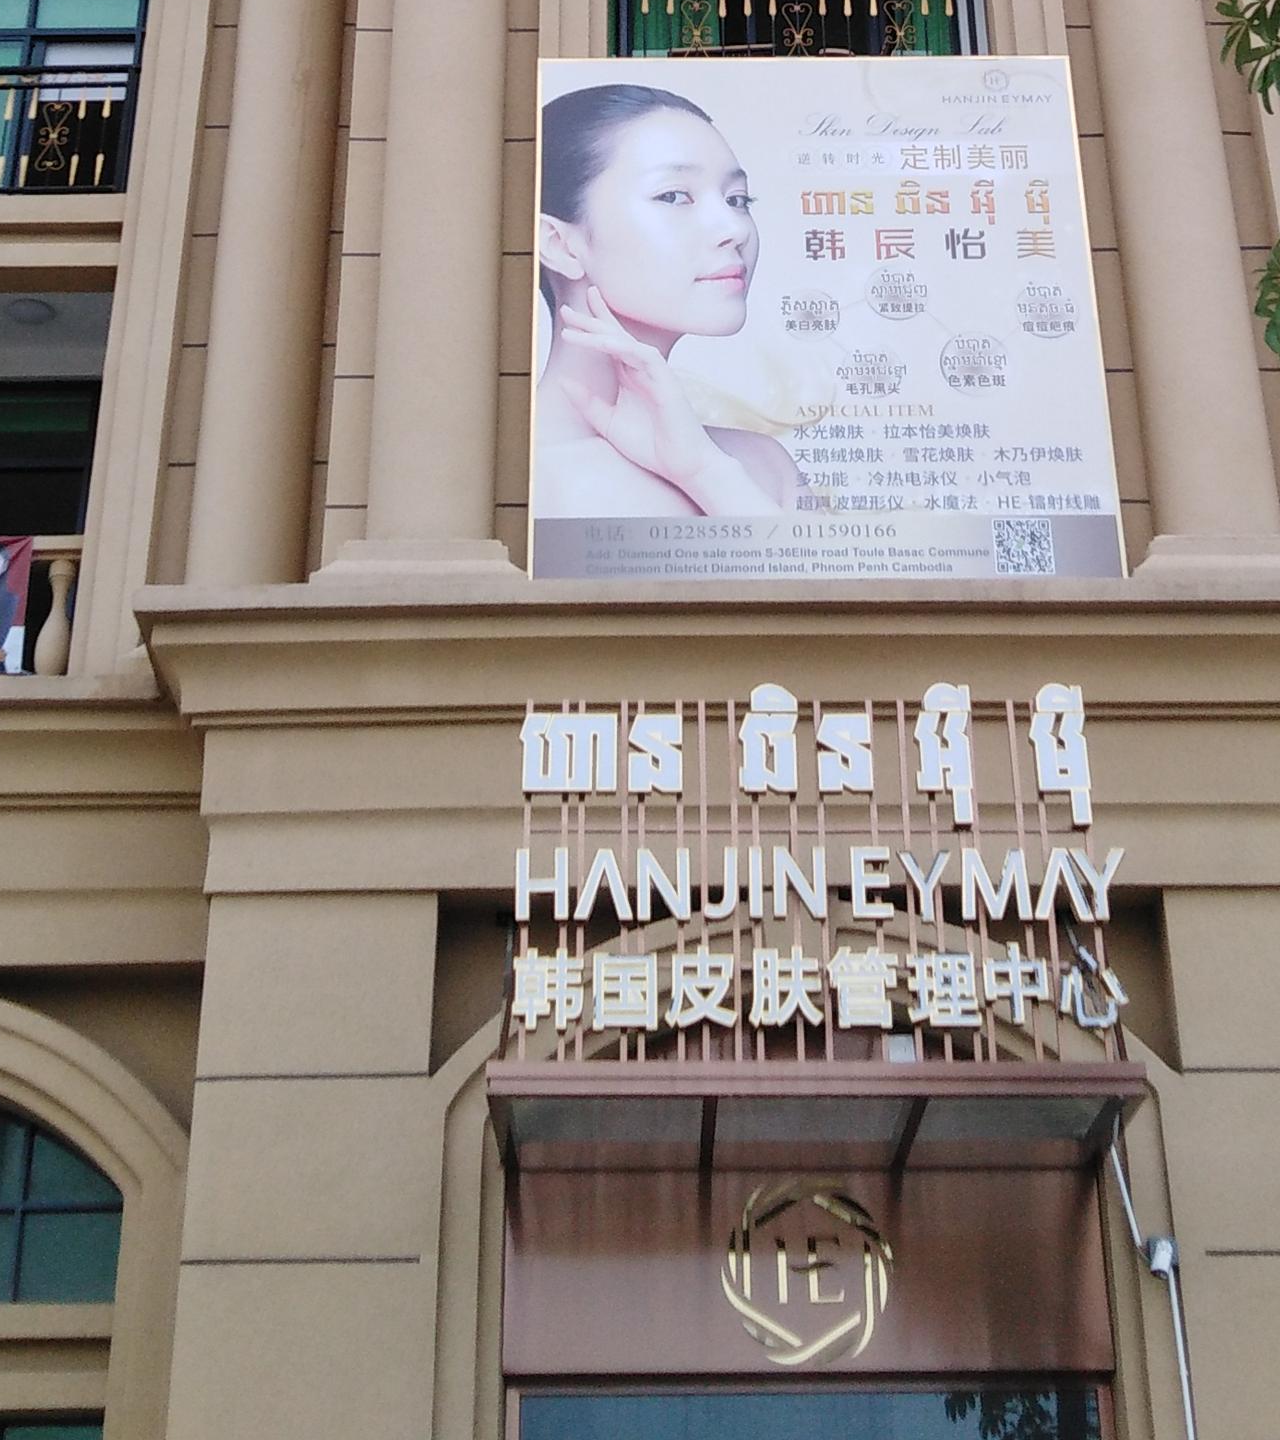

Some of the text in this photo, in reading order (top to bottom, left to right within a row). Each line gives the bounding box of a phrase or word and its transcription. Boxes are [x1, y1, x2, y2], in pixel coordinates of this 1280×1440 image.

[798, 114, 1004, 142] Skin Design Lab
[900, 144, 1029, 171] 定制美丽
[804, 227, 1057, 261] 韩辰怡美
[948, 374, 1007, 387] 色素色斑
[887, 404, 935, 417] ITEM
[793, 424, 865, 440] 水光嫩肤
[902, 446, 975, 463] 雪花焕肤
[993, 446, 1084, 463] 木乃伊焕肤
[795, 471, 850, 487] 多功能
[976, 470, 1032, 486] 小气泡
[649, 524, 753, 540] 012285585
[792, 524, 897, 538] 011590166
[618, 547, 671, 559] Diamond
[674, 547, 699, 559] One
[703, 547, 727, 559] sale
[730, 548, 762, 559] room
[821, 547, 849, 558] road
[928, 546, 990, 558] Commune
[664, 562, 708, 574] District
[711, 562, 765, 574] Diamond
[812, 562, 855, 573] Phnom
[858, 562, 889, 573] Penh
[892, 562, 953, 573] Cambodia
[515, 846, 1126, 922] HANJIN EYMAY
[511, 942, 1129, 1031] 韩国皮肤管理中心
